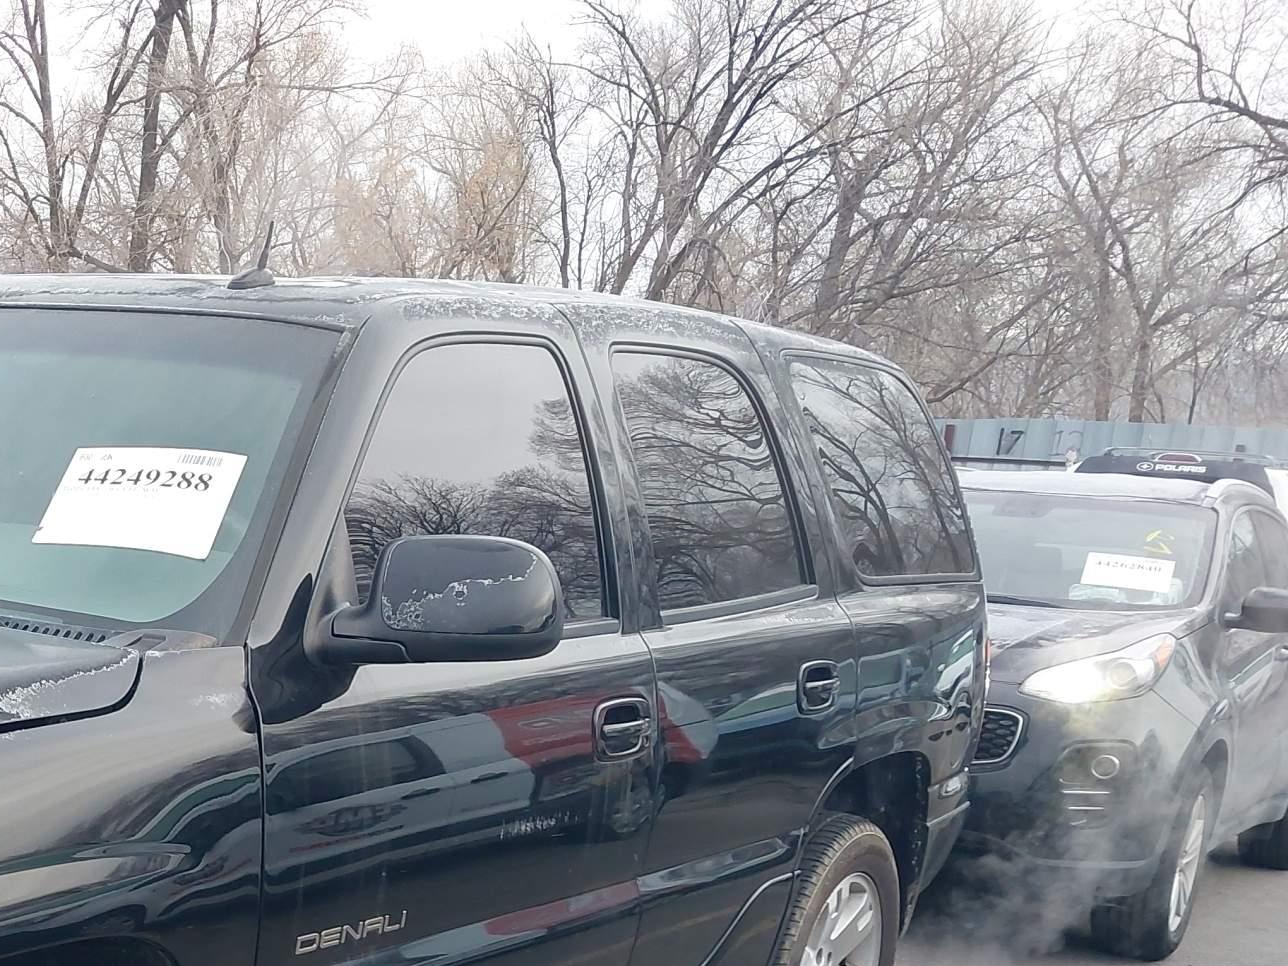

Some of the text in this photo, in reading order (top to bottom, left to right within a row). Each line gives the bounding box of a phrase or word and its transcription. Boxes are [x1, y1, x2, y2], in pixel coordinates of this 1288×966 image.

[996, 427, 1024, 456] 17
[78, 468, 213, 492] 44249288
[1155, 463, 1207, 474] POLARIS
[295, 910, 408, 956] DENALI
